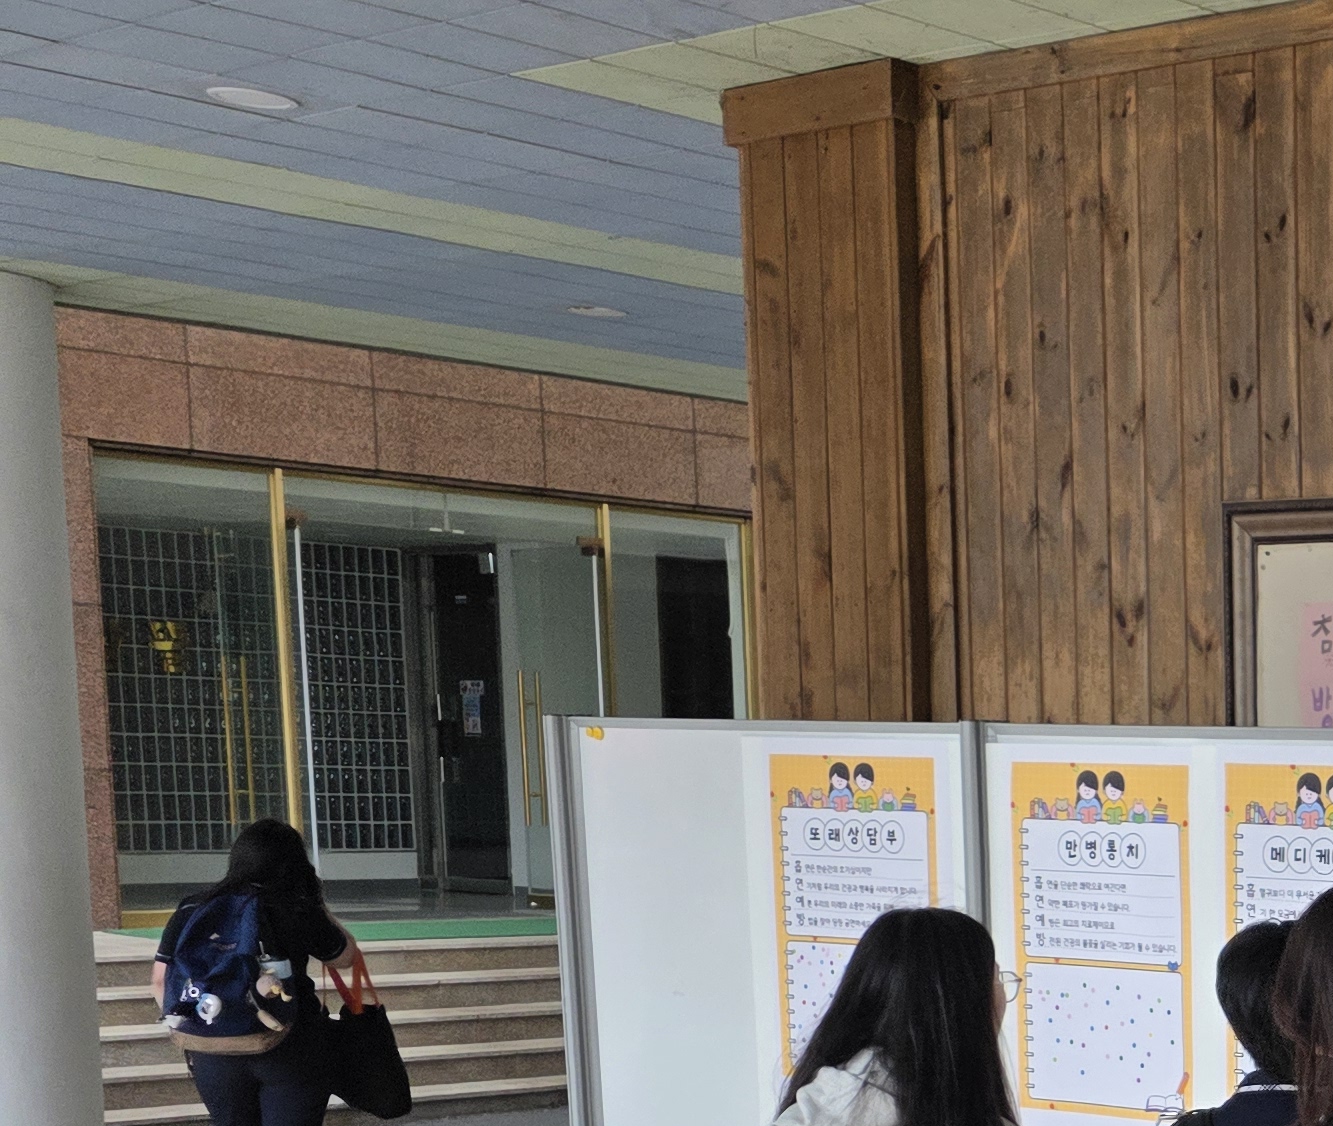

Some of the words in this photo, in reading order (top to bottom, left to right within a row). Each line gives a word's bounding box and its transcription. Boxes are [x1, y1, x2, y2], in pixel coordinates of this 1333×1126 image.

[809, 826, 897, 846] 또래상담부
[1065, 839, 1139, 860] 만병통치
[1246, 904, 1255, 918] 연
